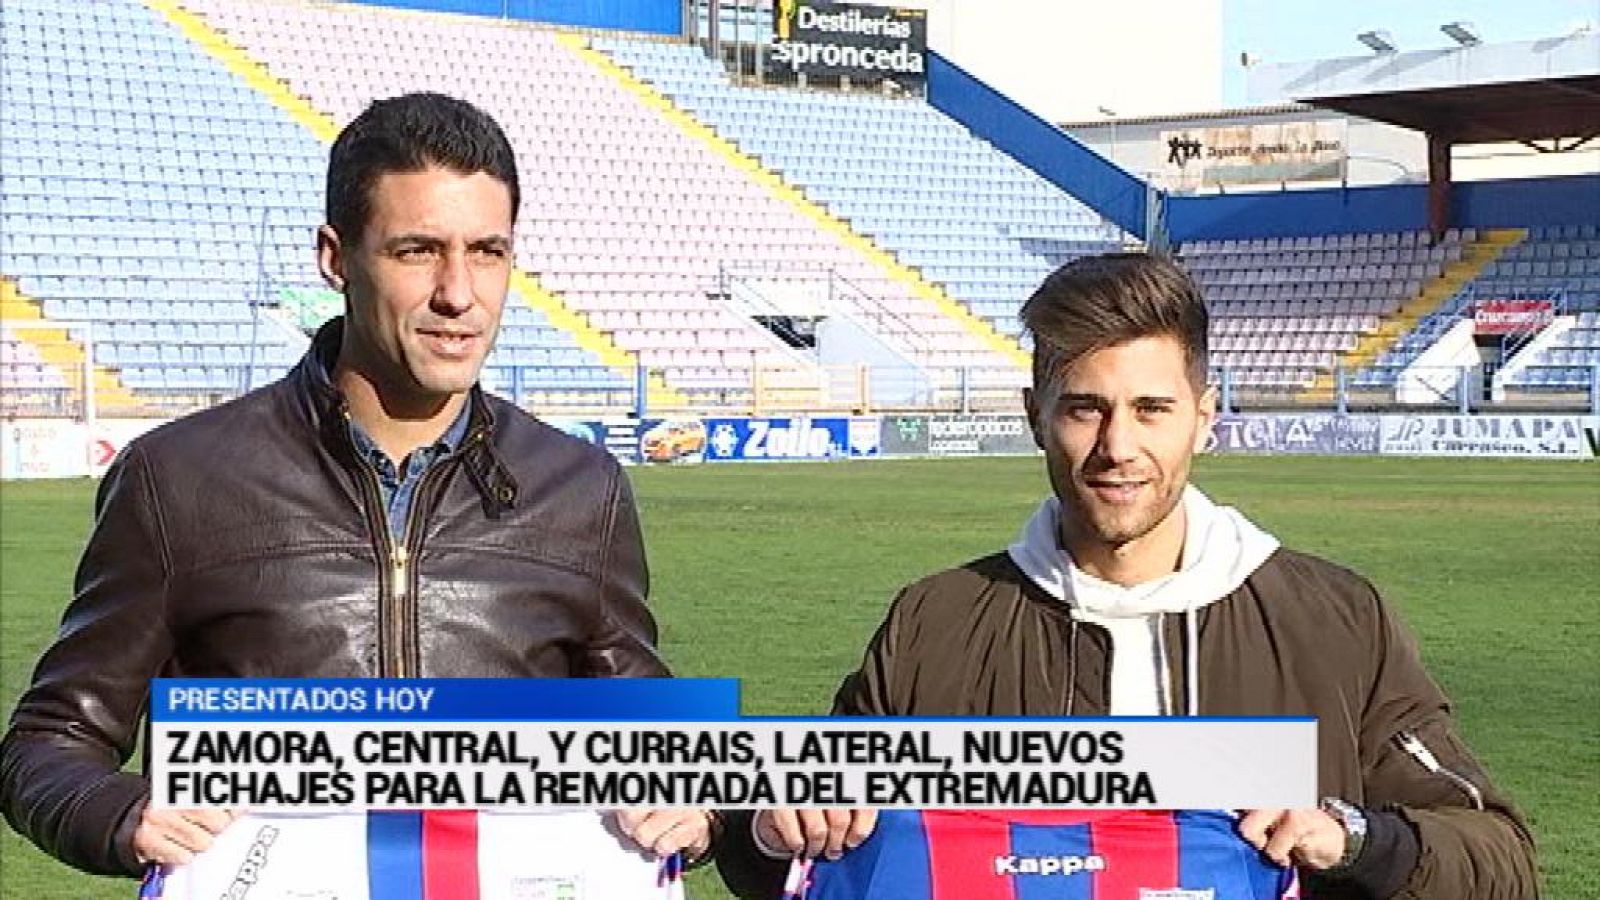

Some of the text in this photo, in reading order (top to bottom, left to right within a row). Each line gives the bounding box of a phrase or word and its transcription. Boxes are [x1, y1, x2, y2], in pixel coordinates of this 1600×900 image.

[799, 6, 911, 37] Destilerías
[1431, 417, 1576, 438] JUMAPA
[220, 825, 281, 900] appa
[994, 855, 1105, 876] Kappa
